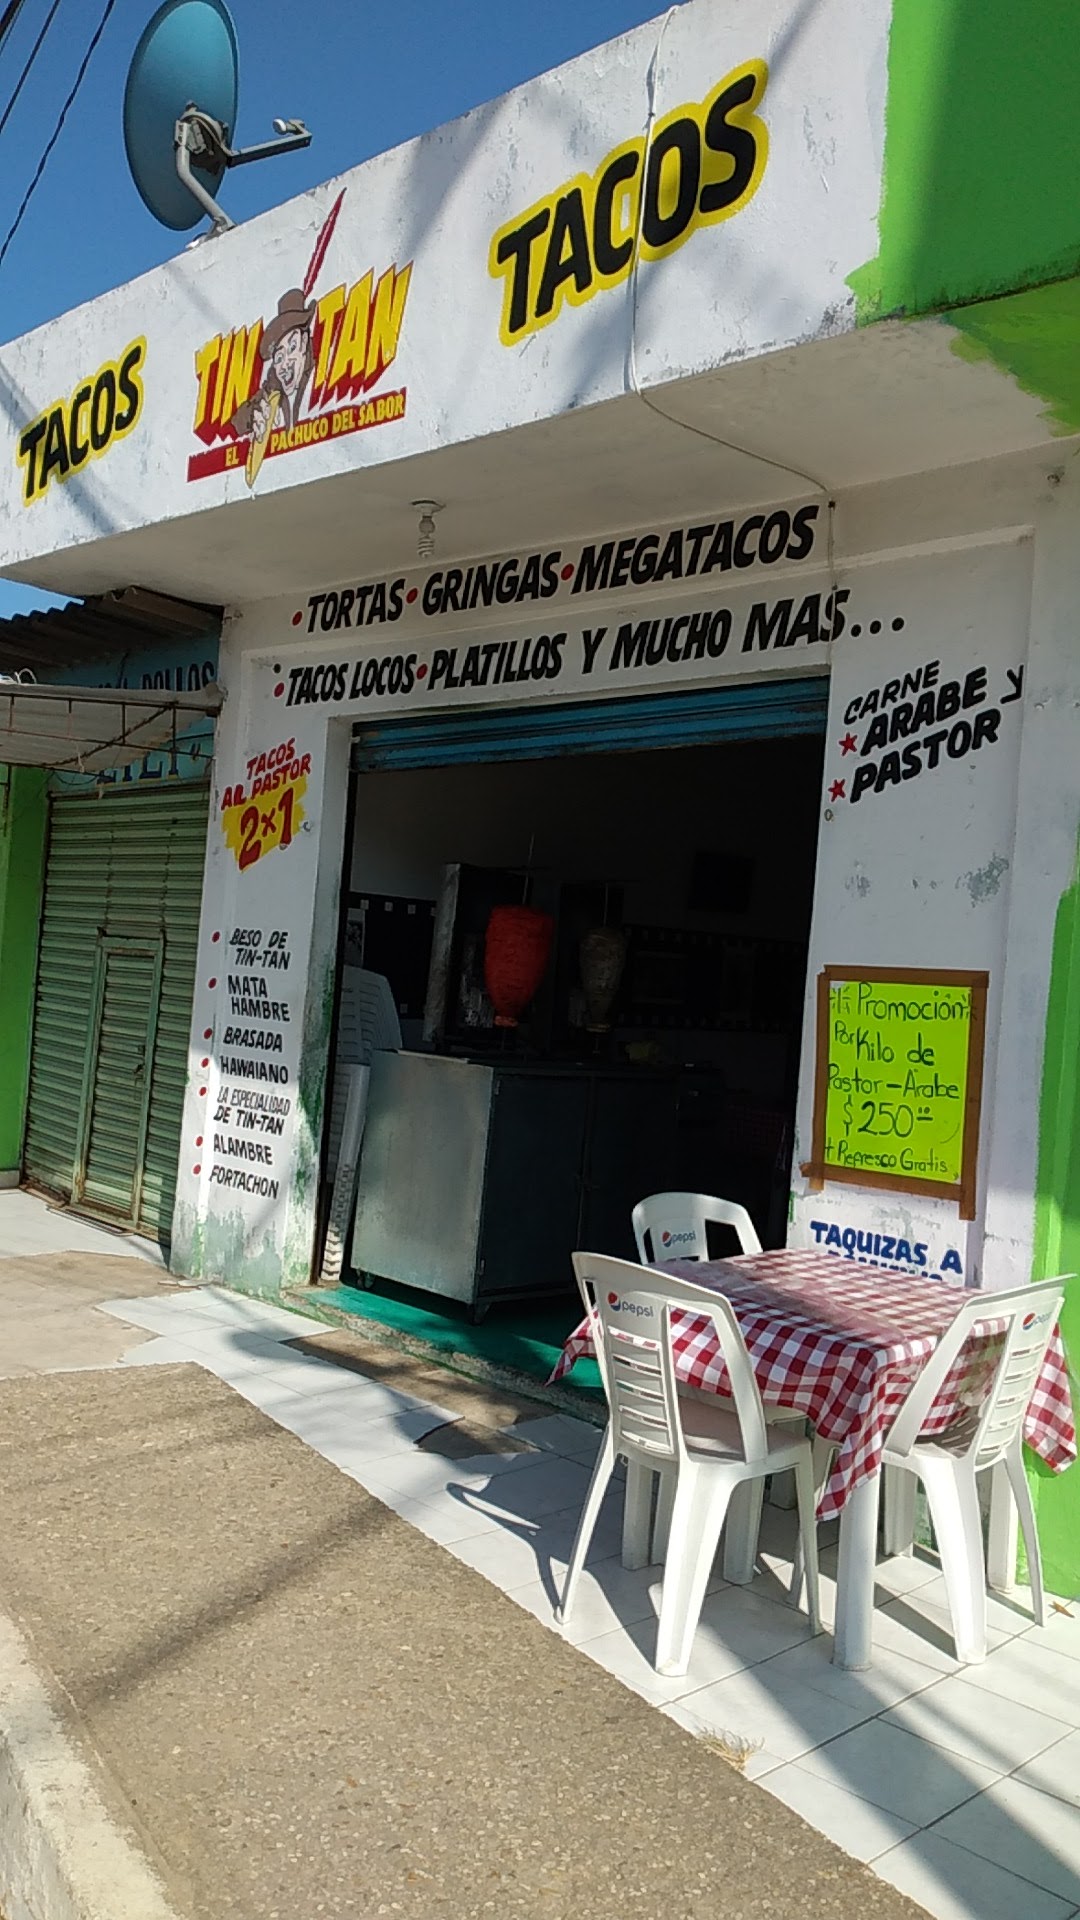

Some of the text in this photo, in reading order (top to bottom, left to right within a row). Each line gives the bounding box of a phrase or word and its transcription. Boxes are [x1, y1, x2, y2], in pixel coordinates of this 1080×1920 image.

[498, 74, 756, 333] TACOS
[194, 261, 413, 438] TIN TAN
[19, 345, 142, 499] TACOS
[225, 393, 404, 467] EL PACHUCO DEL SABOR
[307, 505, 820, 633] TORTAS GRINGAS MEGATACOS
[285, 663, 348, 706] TACOS
[349, 654, 417, 699] LOCOS
[427, 633, 567, 690] PLATILLOS
[581, 627, 607, 675] Y
[608, 609, 732, 671] MUCHO
[844, 660, 940, 725] CARNE
[860, 667, 987, 756] ARABE
[246, 738, 295, 779] TACOS
[850, 708, 1001, 803] PASTOR
[251, 753, 311, 799] PASTOR
[229, 928, 288, 949] BESO DE
[235, 948, 291, 970] TIN-TAN
[227, 975, 268, 998] MATA
[231, 997, 290, 1022] HAMBRE
[223, 1027, 283, 1053] BRASADA
[856, 1026, 895, 1063] Kilo
[907, 1032, 935, 1067] de
[220, 1056, 289, 1084] HAWAIANO
[217, 1086, 291, 1116] LA ESPECIALIDAD
[213, 1105, 285, 1136] DE TIN-TAN
[213, 1133, 273, 1165] ALAMBRE
[837, 1140, 897, 1169] Refresco
[900, 1147, 948, 1172] Gratis
[209, 1165, 280, 1199] FORTACHON
[671, 1230, 696, 1245] pepsi
[810, 1220, 928, 1266] TAQUIZAS
[940, 1249, 963, 1274] A
[621, 1302, 654, 1317] pepsi
